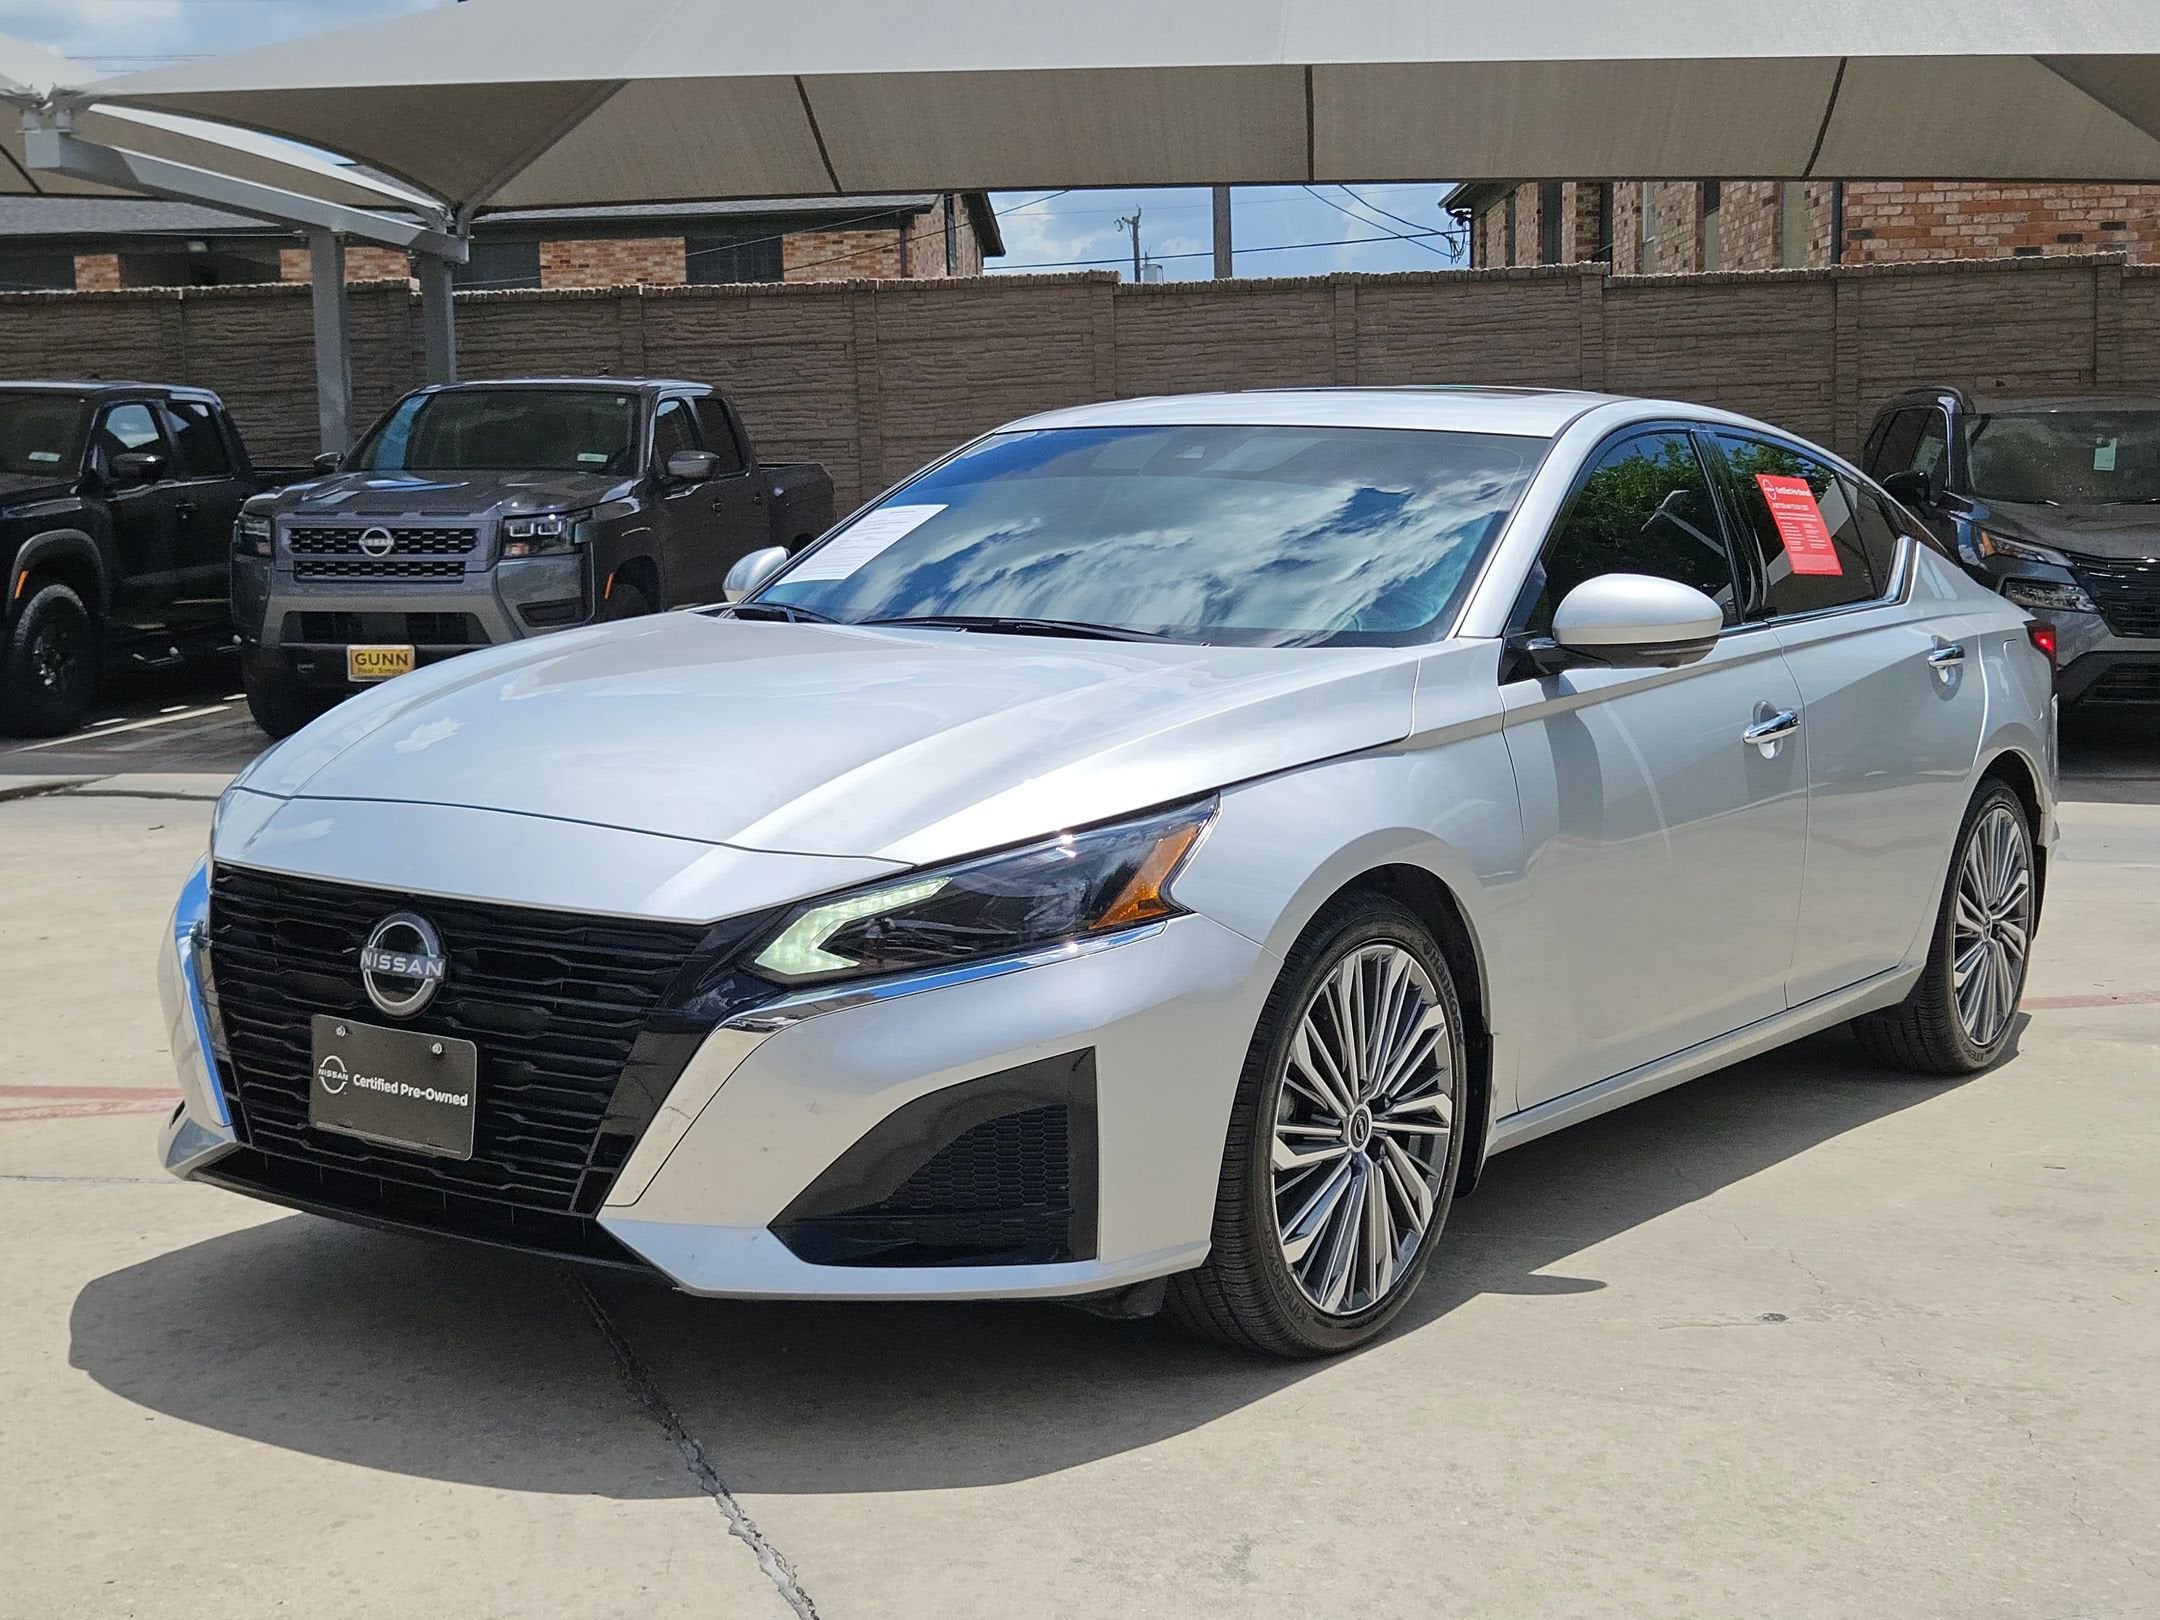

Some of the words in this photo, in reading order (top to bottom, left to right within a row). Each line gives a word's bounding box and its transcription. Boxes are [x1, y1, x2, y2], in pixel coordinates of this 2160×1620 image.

[355, 653, 409, 666] GUNN
[361, 950, 444, 978] NISSAN
[318, 1068, 349, 1081] NISSAN
[353, 1073, 399, 1095] Certified
[400, 1083, 469, 1106] Pre-Owned
